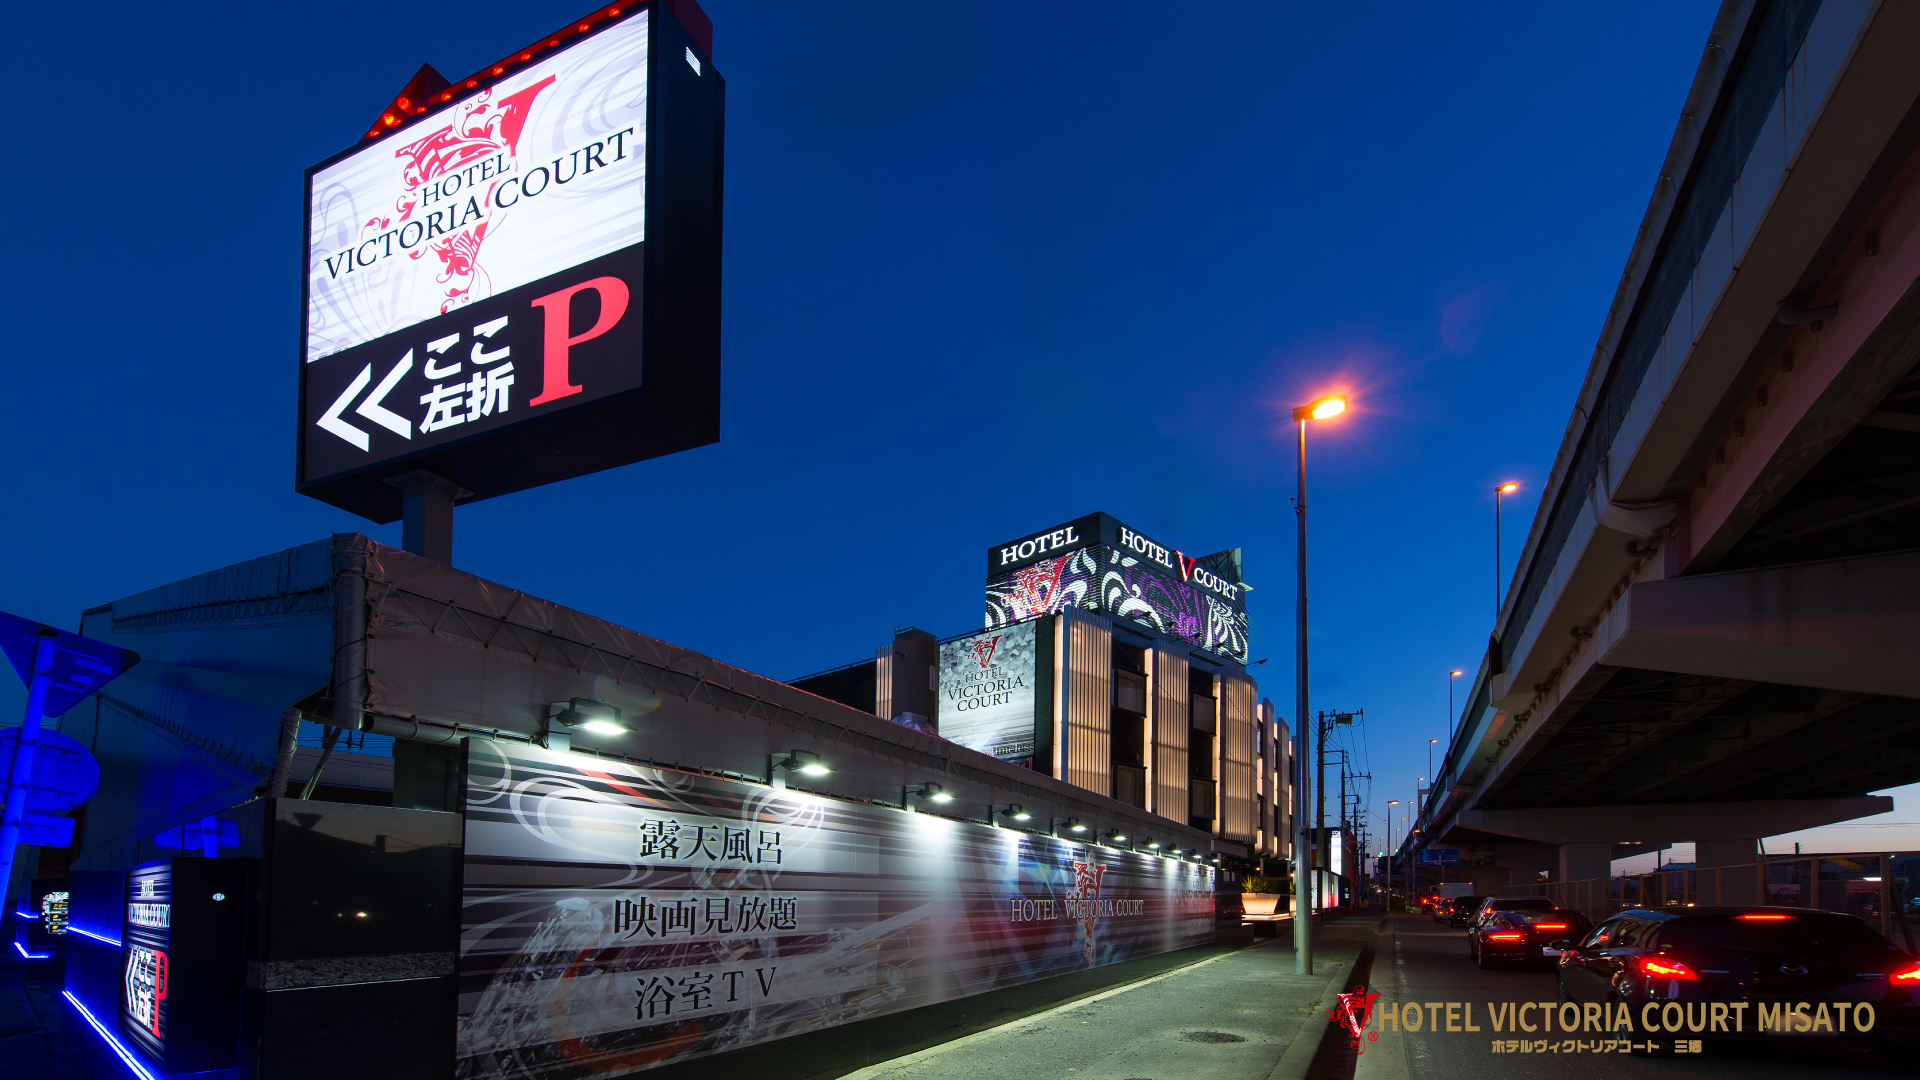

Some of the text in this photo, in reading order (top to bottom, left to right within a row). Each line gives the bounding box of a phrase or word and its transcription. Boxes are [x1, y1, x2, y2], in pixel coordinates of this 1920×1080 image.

[324, 127, 634, 280] VICTORIA COURT
[420, 152, 510, 208] HOTEL
[423, 315, 510, 380] ここ
[529, 276, 630, 407] P
[419, 360, 515, 435] 左折
[1000, 526, 1079, 565] HOTEL
[1121, 526, 1238, 601] HOTEL V COURT
[947, 675, 1025, 701] VICTORIA
[965, 666, 1005, 683] HOTEL
[957, 690, 1013, 712] COURT
[638, 818, 784, 865] 露天風呂
[613, 896, 798, 940] 映画見放題
[1010, 899, 1145, 922] HOTEL VICTORIA COURT
[152, 950, 168, 1039] P
